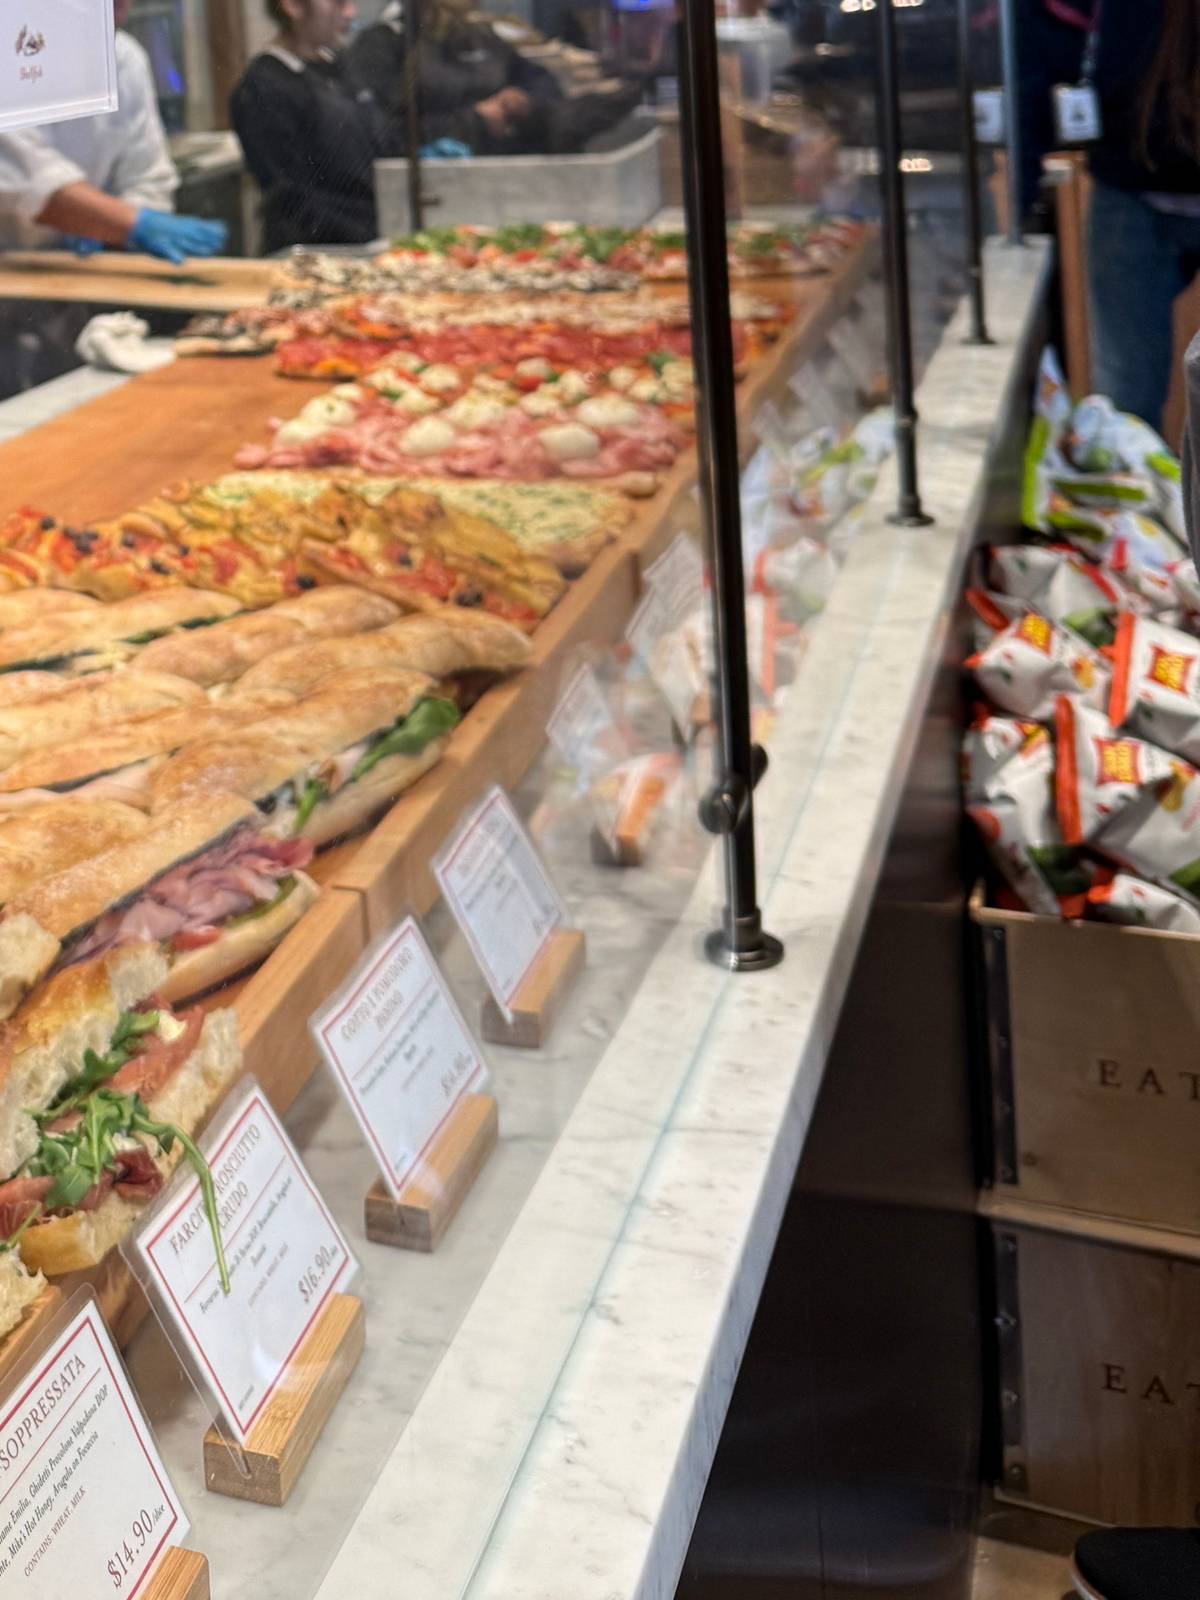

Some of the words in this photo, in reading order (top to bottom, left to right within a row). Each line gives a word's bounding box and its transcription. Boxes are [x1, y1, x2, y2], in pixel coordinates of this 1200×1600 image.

[214, 1124, 260, 1194] ROSCIUTTO
[219, 1181, 248, 1229] CRUDO
[94, 1383, 108, 1407] DOP
[7, 1529, 26, 1559] Mike's
[23, 1516, 37, 1536] Hot
[52, 1466, 73, 1497] Arugula
[71, 1457, 80, 1470] on
[69, 1485, 85, 1508] MILK
